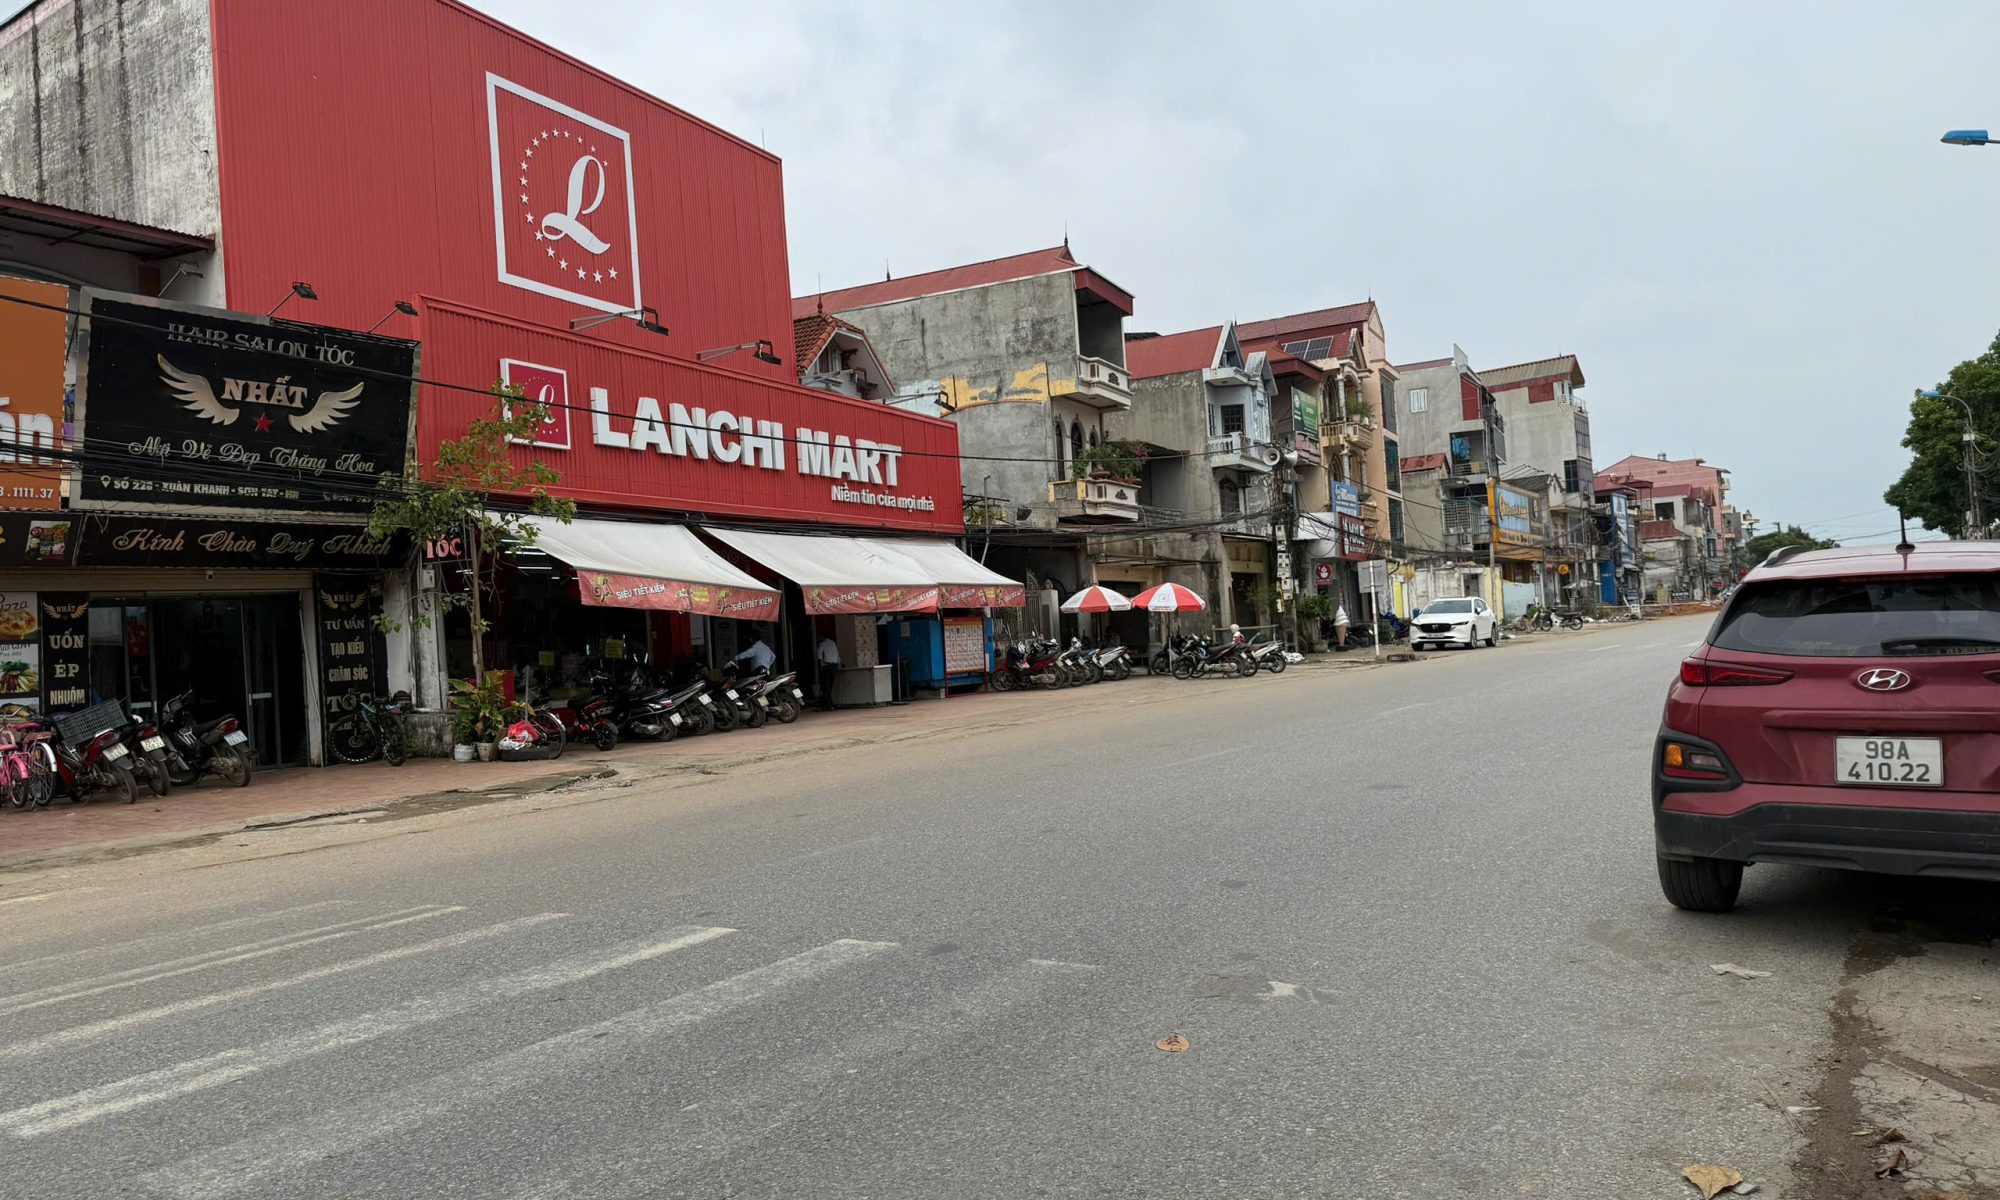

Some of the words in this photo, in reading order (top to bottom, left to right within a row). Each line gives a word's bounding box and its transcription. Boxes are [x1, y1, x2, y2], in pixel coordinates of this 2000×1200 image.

[234, 333, 308, 358] SALON
[315, 344, 355, 366] TÓC
[221, 375, 308, 408] NHẤT
[590, 387, 785, 471] LANCHI
[796, 427, 902, 487] MART
[270, 446, 328, 476] Thăng
[335, 453, 376, 473] Hoa
[194, 483, 229, 496] KHANH
[831, 482, 861, 504] Niềm
[861, 488, 876, 505] tin
[876, 490, 897, 508] của
[897, 494, 916, 513] mọi
[917, 496, 935, 512] nhà
[113, 528, 186, 551] Kính
[198, 530, 257, 552] Chào
[325, 618, 341, 630] TƯ
[344, 614, 365, 630] VẤN
[48, 628, 85, 649] UỐN
[54, 659, 80, 678] ÉP
[50, 686, 85, 707] NHUỘM
[1865, 740, 1910, 760] 98A
[1848, 762, 1930, 783] 410.22
